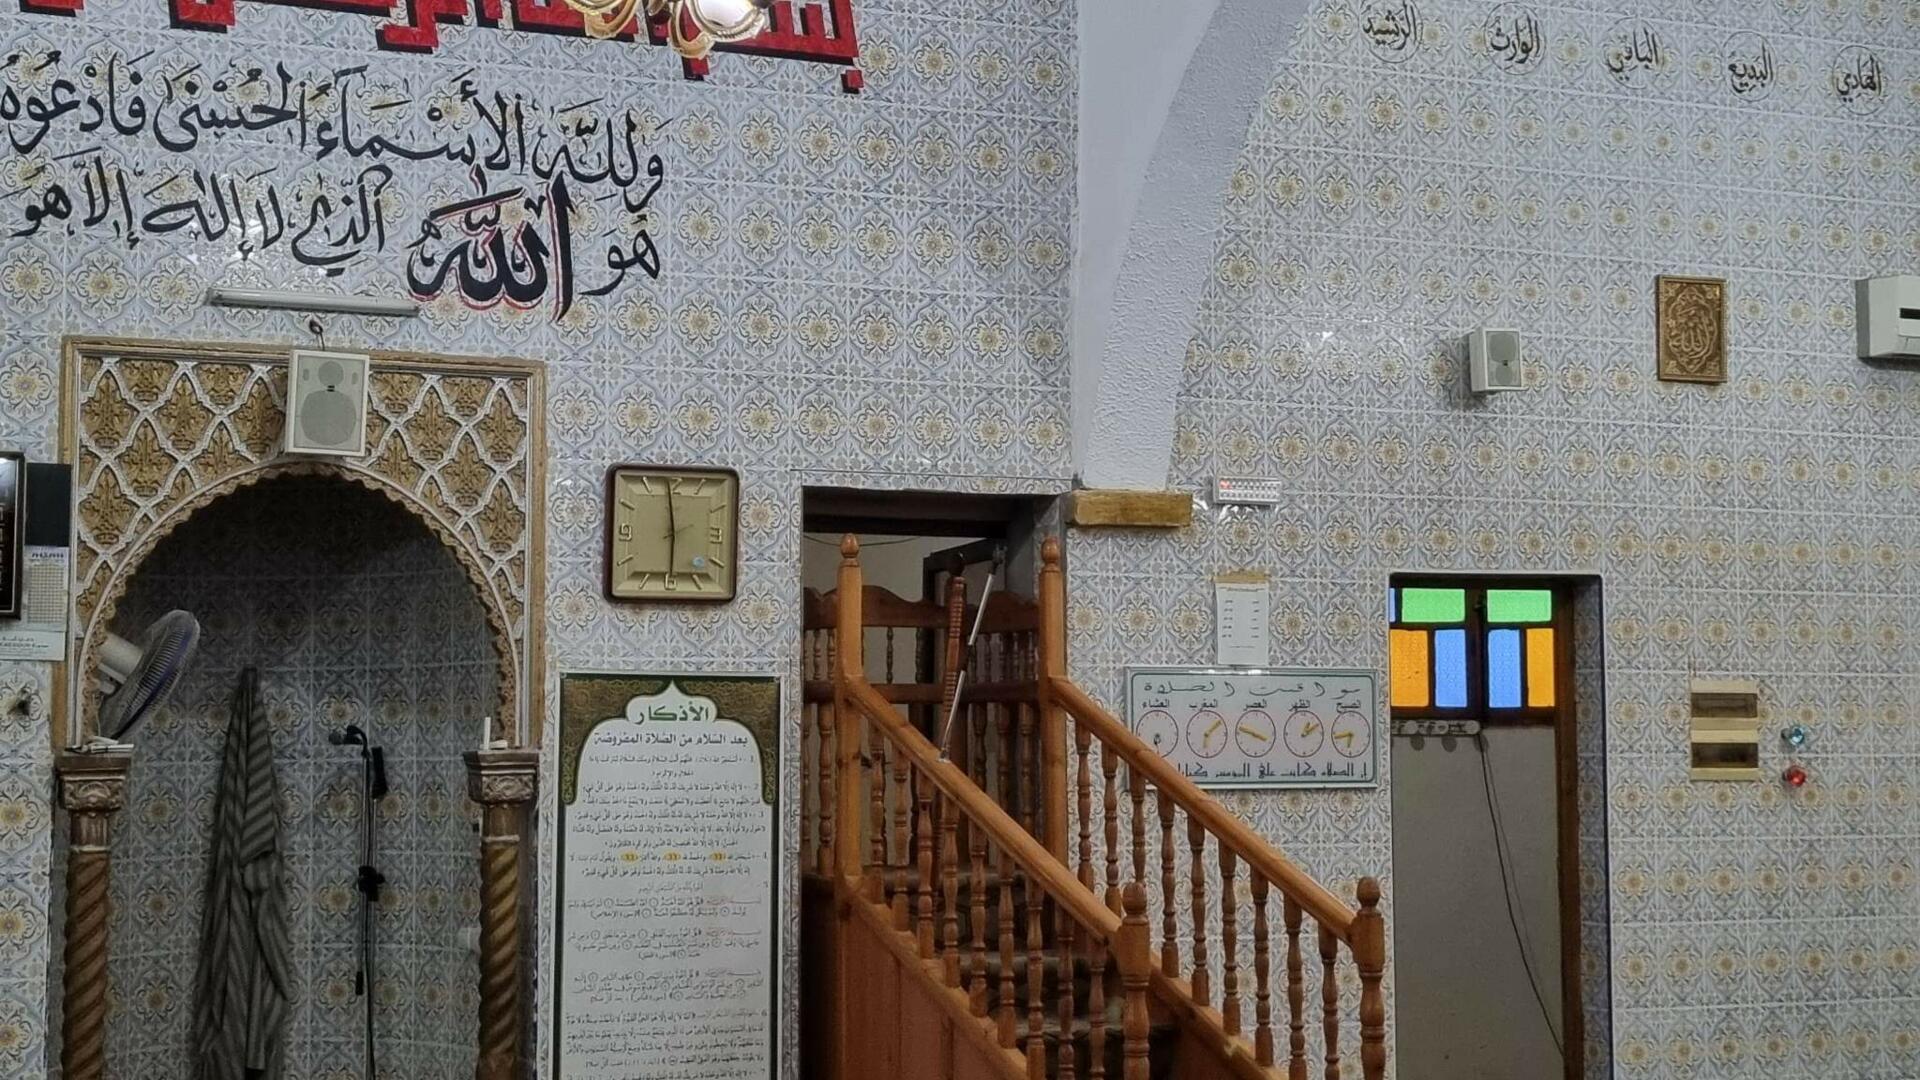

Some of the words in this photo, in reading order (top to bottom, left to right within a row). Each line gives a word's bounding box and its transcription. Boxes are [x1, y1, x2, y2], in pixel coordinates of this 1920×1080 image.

[1362, 2, 1418, 50] الرشيد
[1490, 13, 1541, 64] الوارث
[1607, 27, 1660, 81] الباقي
[1728, 41, 1775, 93] البديع
[1836, 53, 1883, 102] الهادي
[153, 60, 307, 154] الحسنى
[11, 166, 73, 237] هو
[247, 169, 285, 250] لا
[404, 163, 577, 323] الله
[578, 214, 661, 296] هو
[634, 700, 709, 725] الأذكار
[594, 732, 643, 748] المفروضة
[645, 732, 677, 746] الصلاة
[678, 733, 693, 748] من
[695, 732, 727, 746] السلام
[730, 734, 748, 748] بعد
